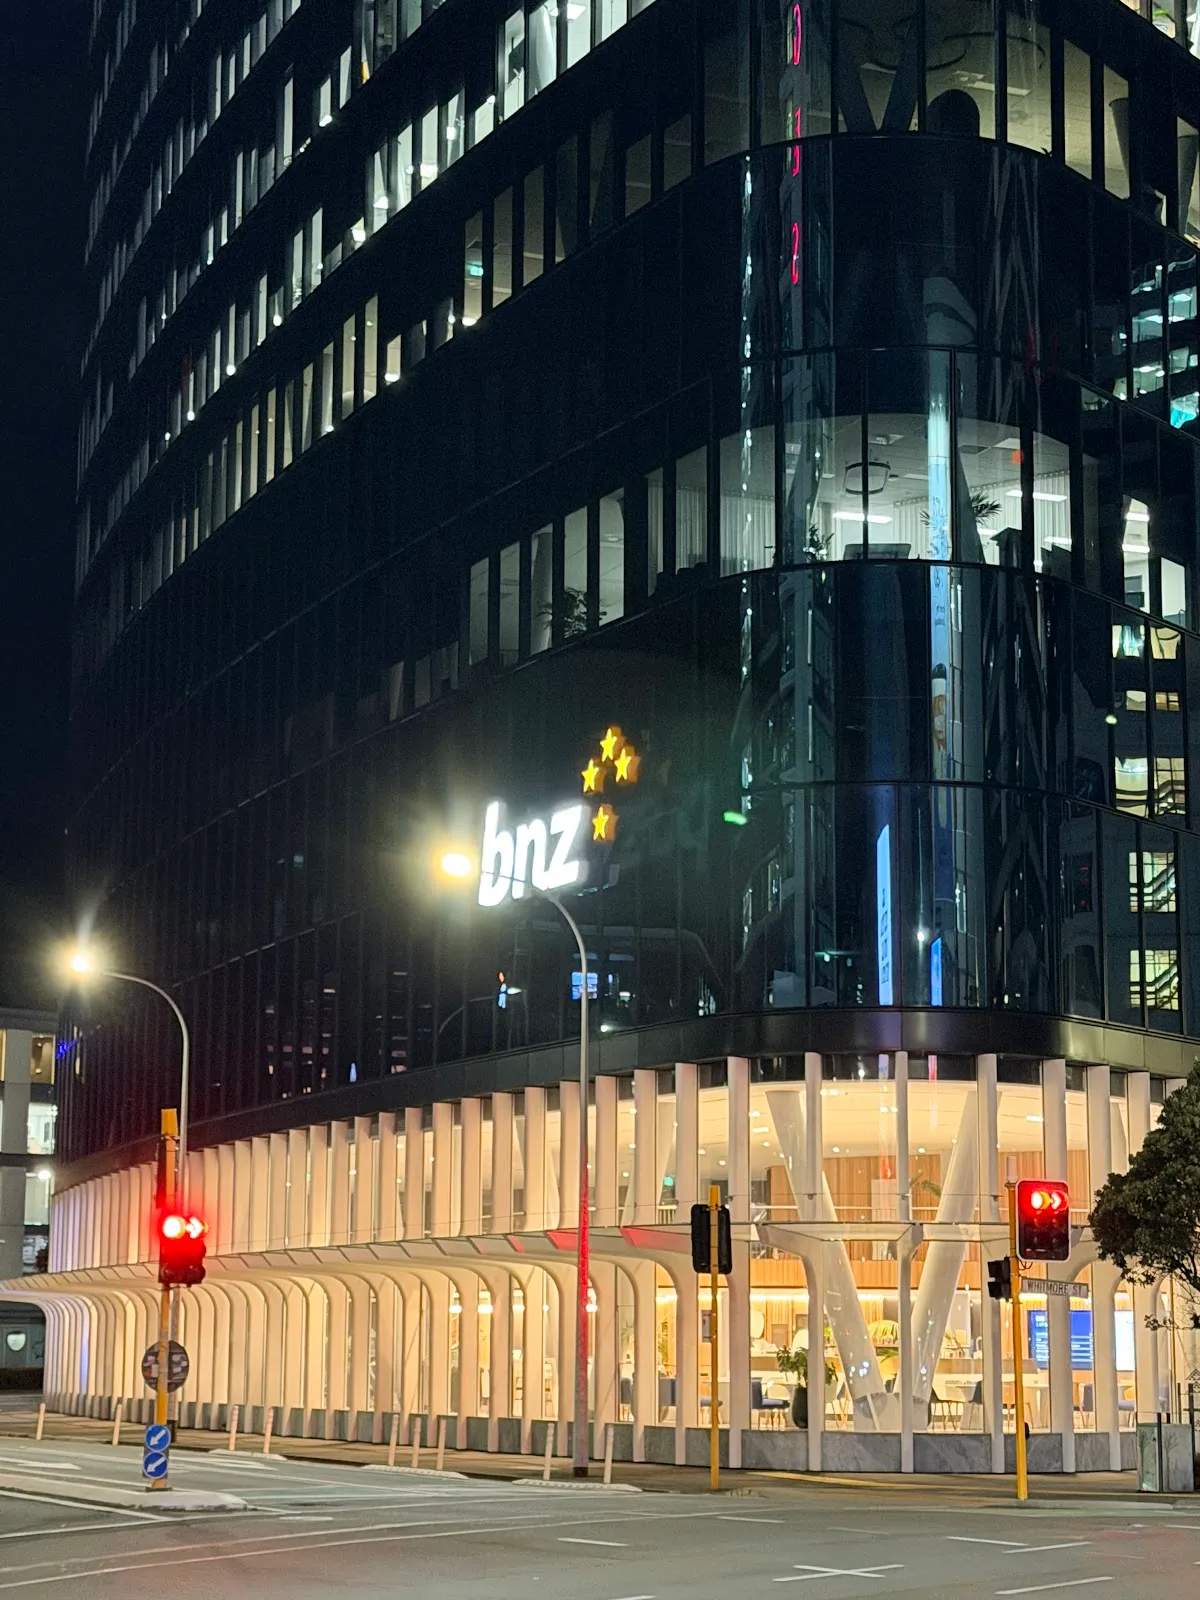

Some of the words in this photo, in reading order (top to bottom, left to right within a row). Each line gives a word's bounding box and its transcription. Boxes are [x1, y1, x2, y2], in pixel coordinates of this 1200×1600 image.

[477, 800, 584, 908] bnz
[1027, 1279, 1068, 1296] WHITMORE
[1072, 1284, 1082, 1294] ST
